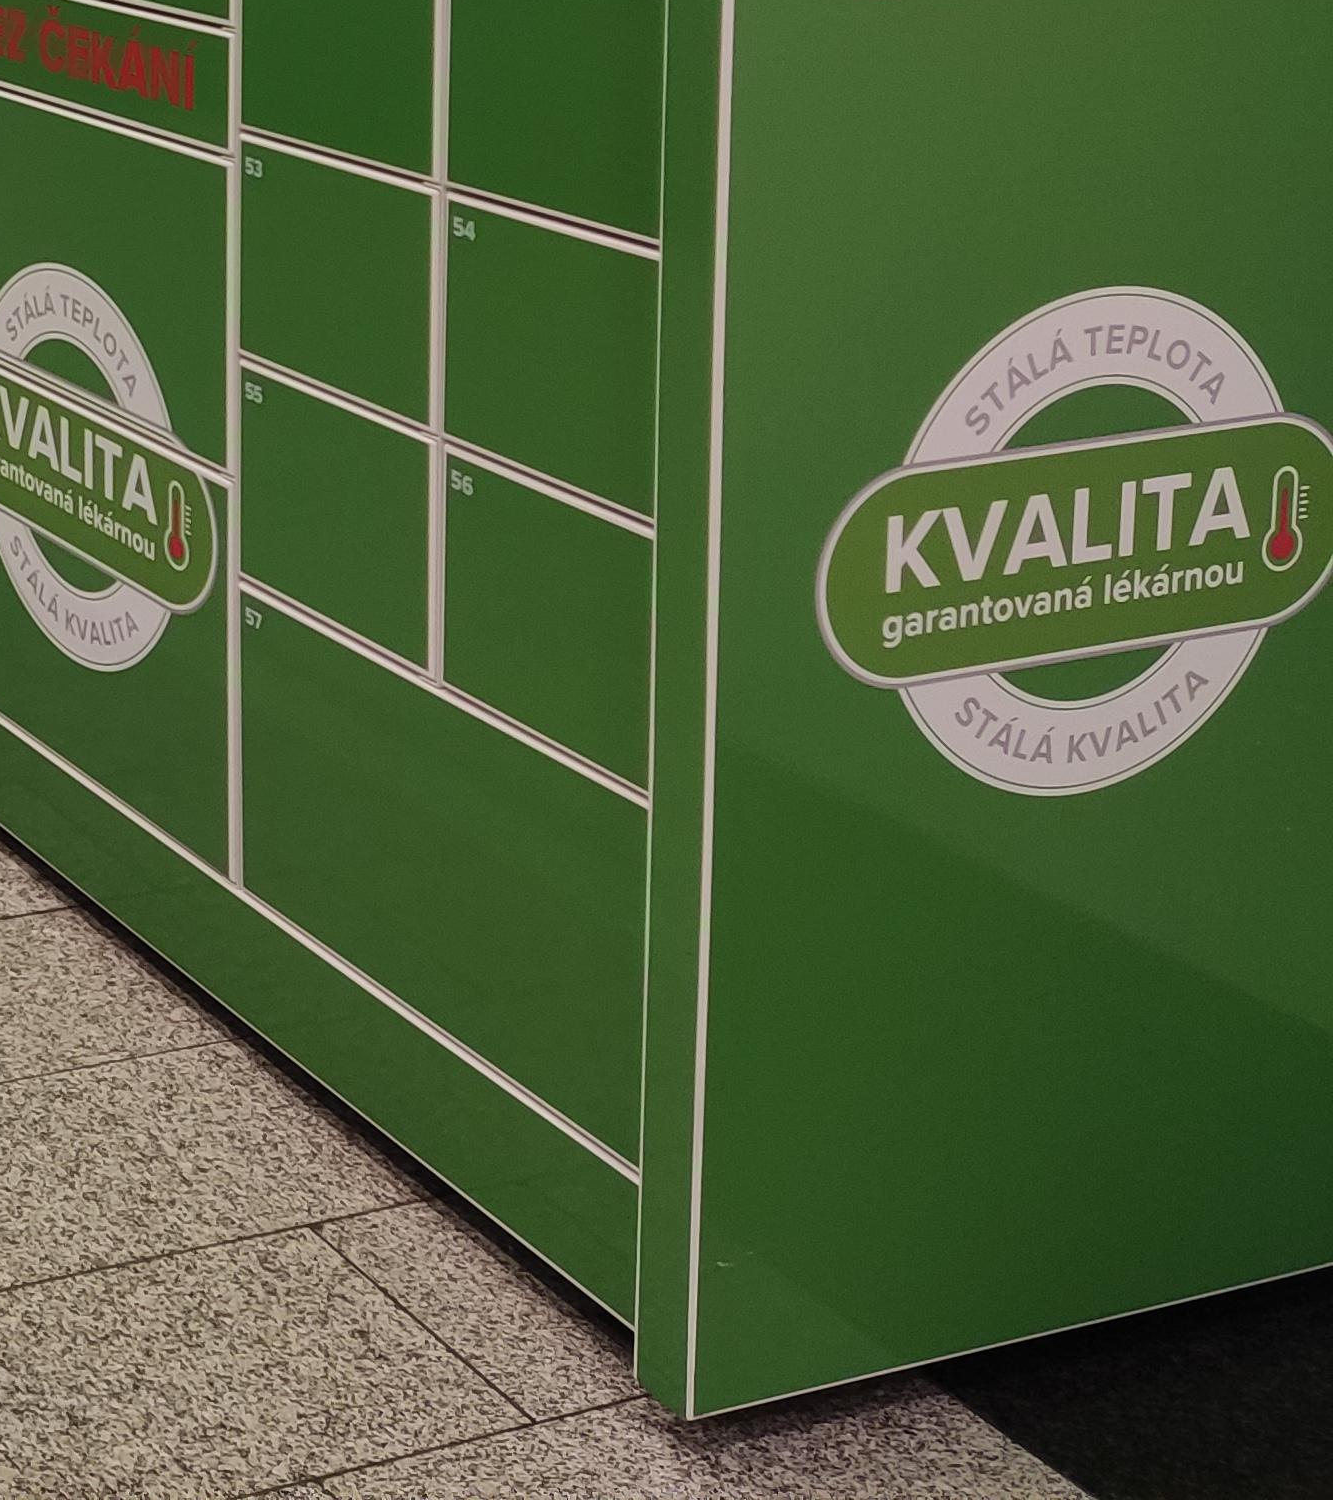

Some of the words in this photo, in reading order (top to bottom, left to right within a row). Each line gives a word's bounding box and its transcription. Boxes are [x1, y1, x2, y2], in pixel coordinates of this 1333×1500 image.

[38, 4, 197, 111] ČEKÁNÍ
[244, 156, 263, 178] 53
[452, 216, 476, 241] 54
[5, 285, 56, 342] STÁLÁ
[60, 294, 138, 398] TEPLOTA
[965, 329, 1074, 437] STÁLÁ
[1084, 325, 1227, 405] TEPLOTA
[244, 381, 263, 404] 55
[450, 469, 474, 496] 56
[78, 499, 156, 562] lékárnou
[885, 466, 1251, 594] KVALITA
[10, 534, 59, 622] STÁLÁ
[64, 611, 140, 646] KVALITA
[244, 606, 262, 629] 57
[881, 576, 1093, 649] garantovaná
[1103, 560, 1245, 606] lékárnou
[955, 696, 1054, 765] STÁLÁ
[1066, 668, 1211, 765] KVALITA
